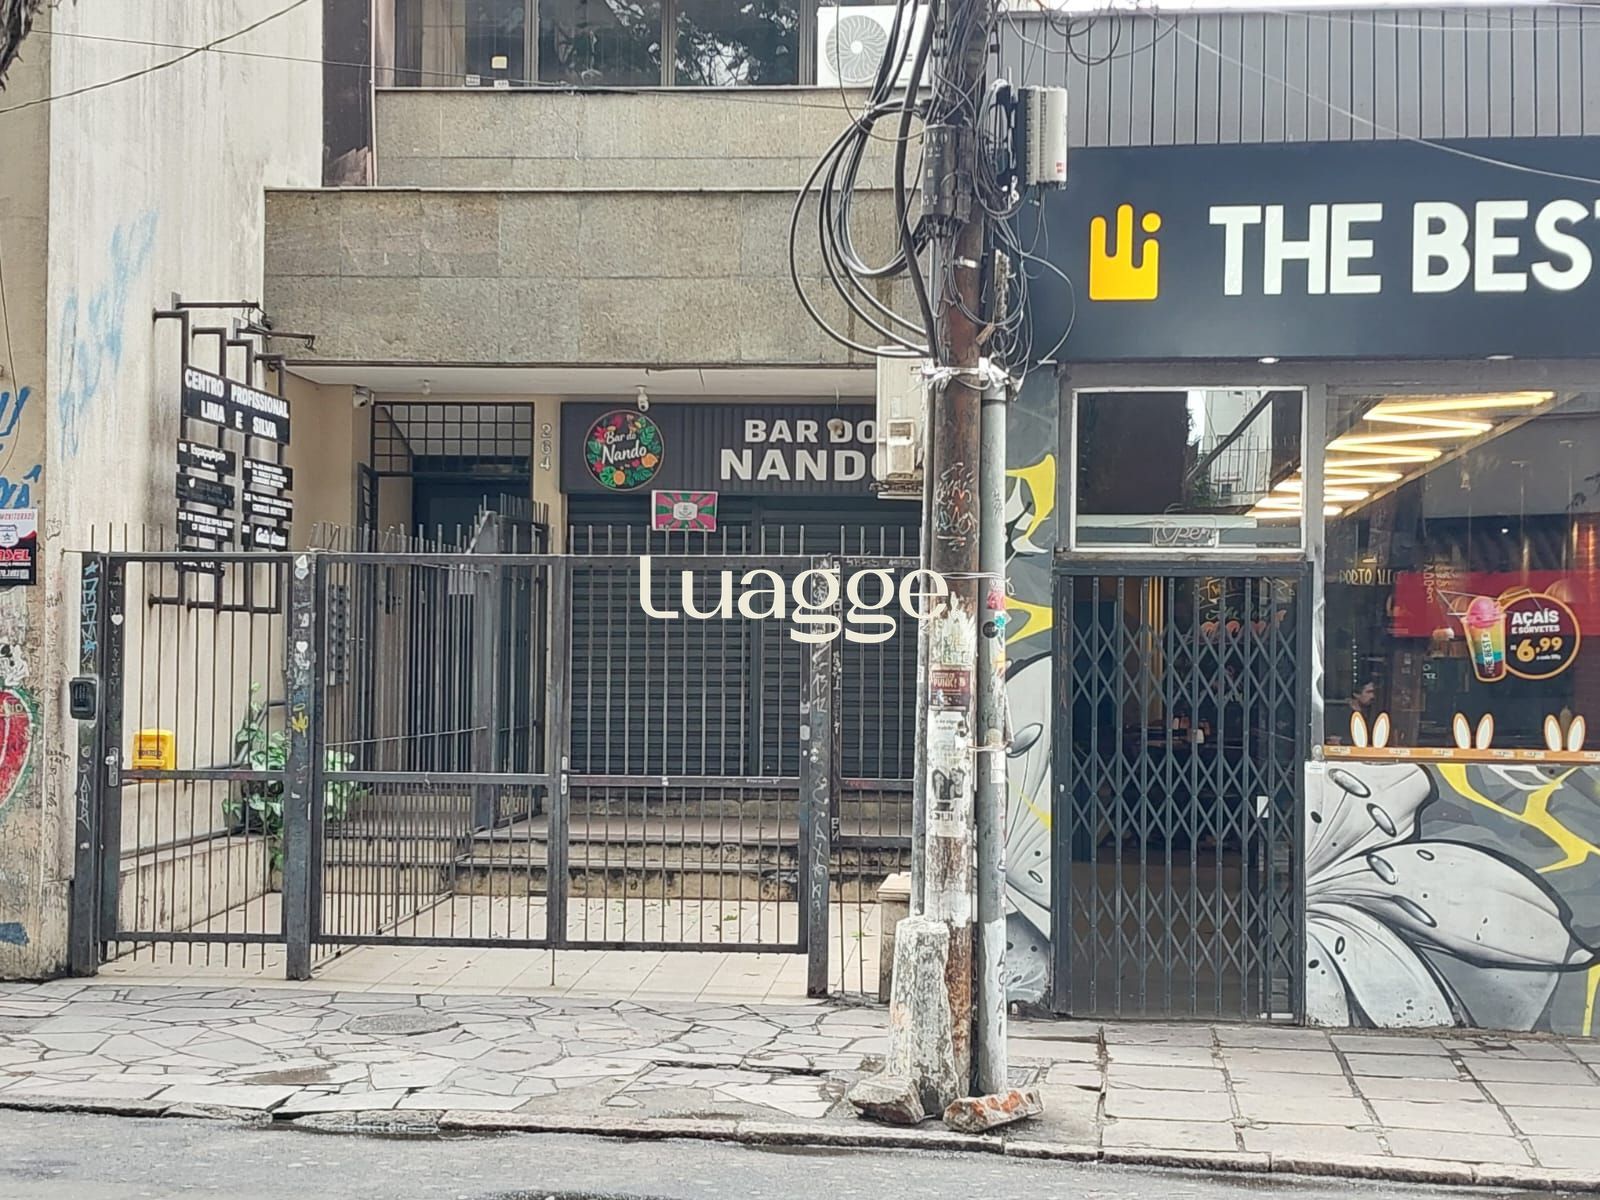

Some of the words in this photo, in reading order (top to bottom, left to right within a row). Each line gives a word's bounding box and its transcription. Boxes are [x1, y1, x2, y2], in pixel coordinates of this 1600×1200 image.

[1208, 202, 1383, 296] THE
[1412, 198, 1600, 293] BES
[184, 368, 225, 398] CENTRO
[231, 383, 290, 419] PROFISSIONAL
[200, 399, 226, 424] LIMA
[235, 410, 244, 430] E
[252, 416, 277, 440] SILVA
[744, 419, 818, 443] BAR
[604, 430, 625, 445] Bar
[601, 440, 647, 465] Nando
[720, 449, 877, 482] NAND
[1511, 607, 1559, 627] AÇAÍS
[1518, 624, 1560, 634] SORVETES
[1516, 636, 1563, 663] 6,99
